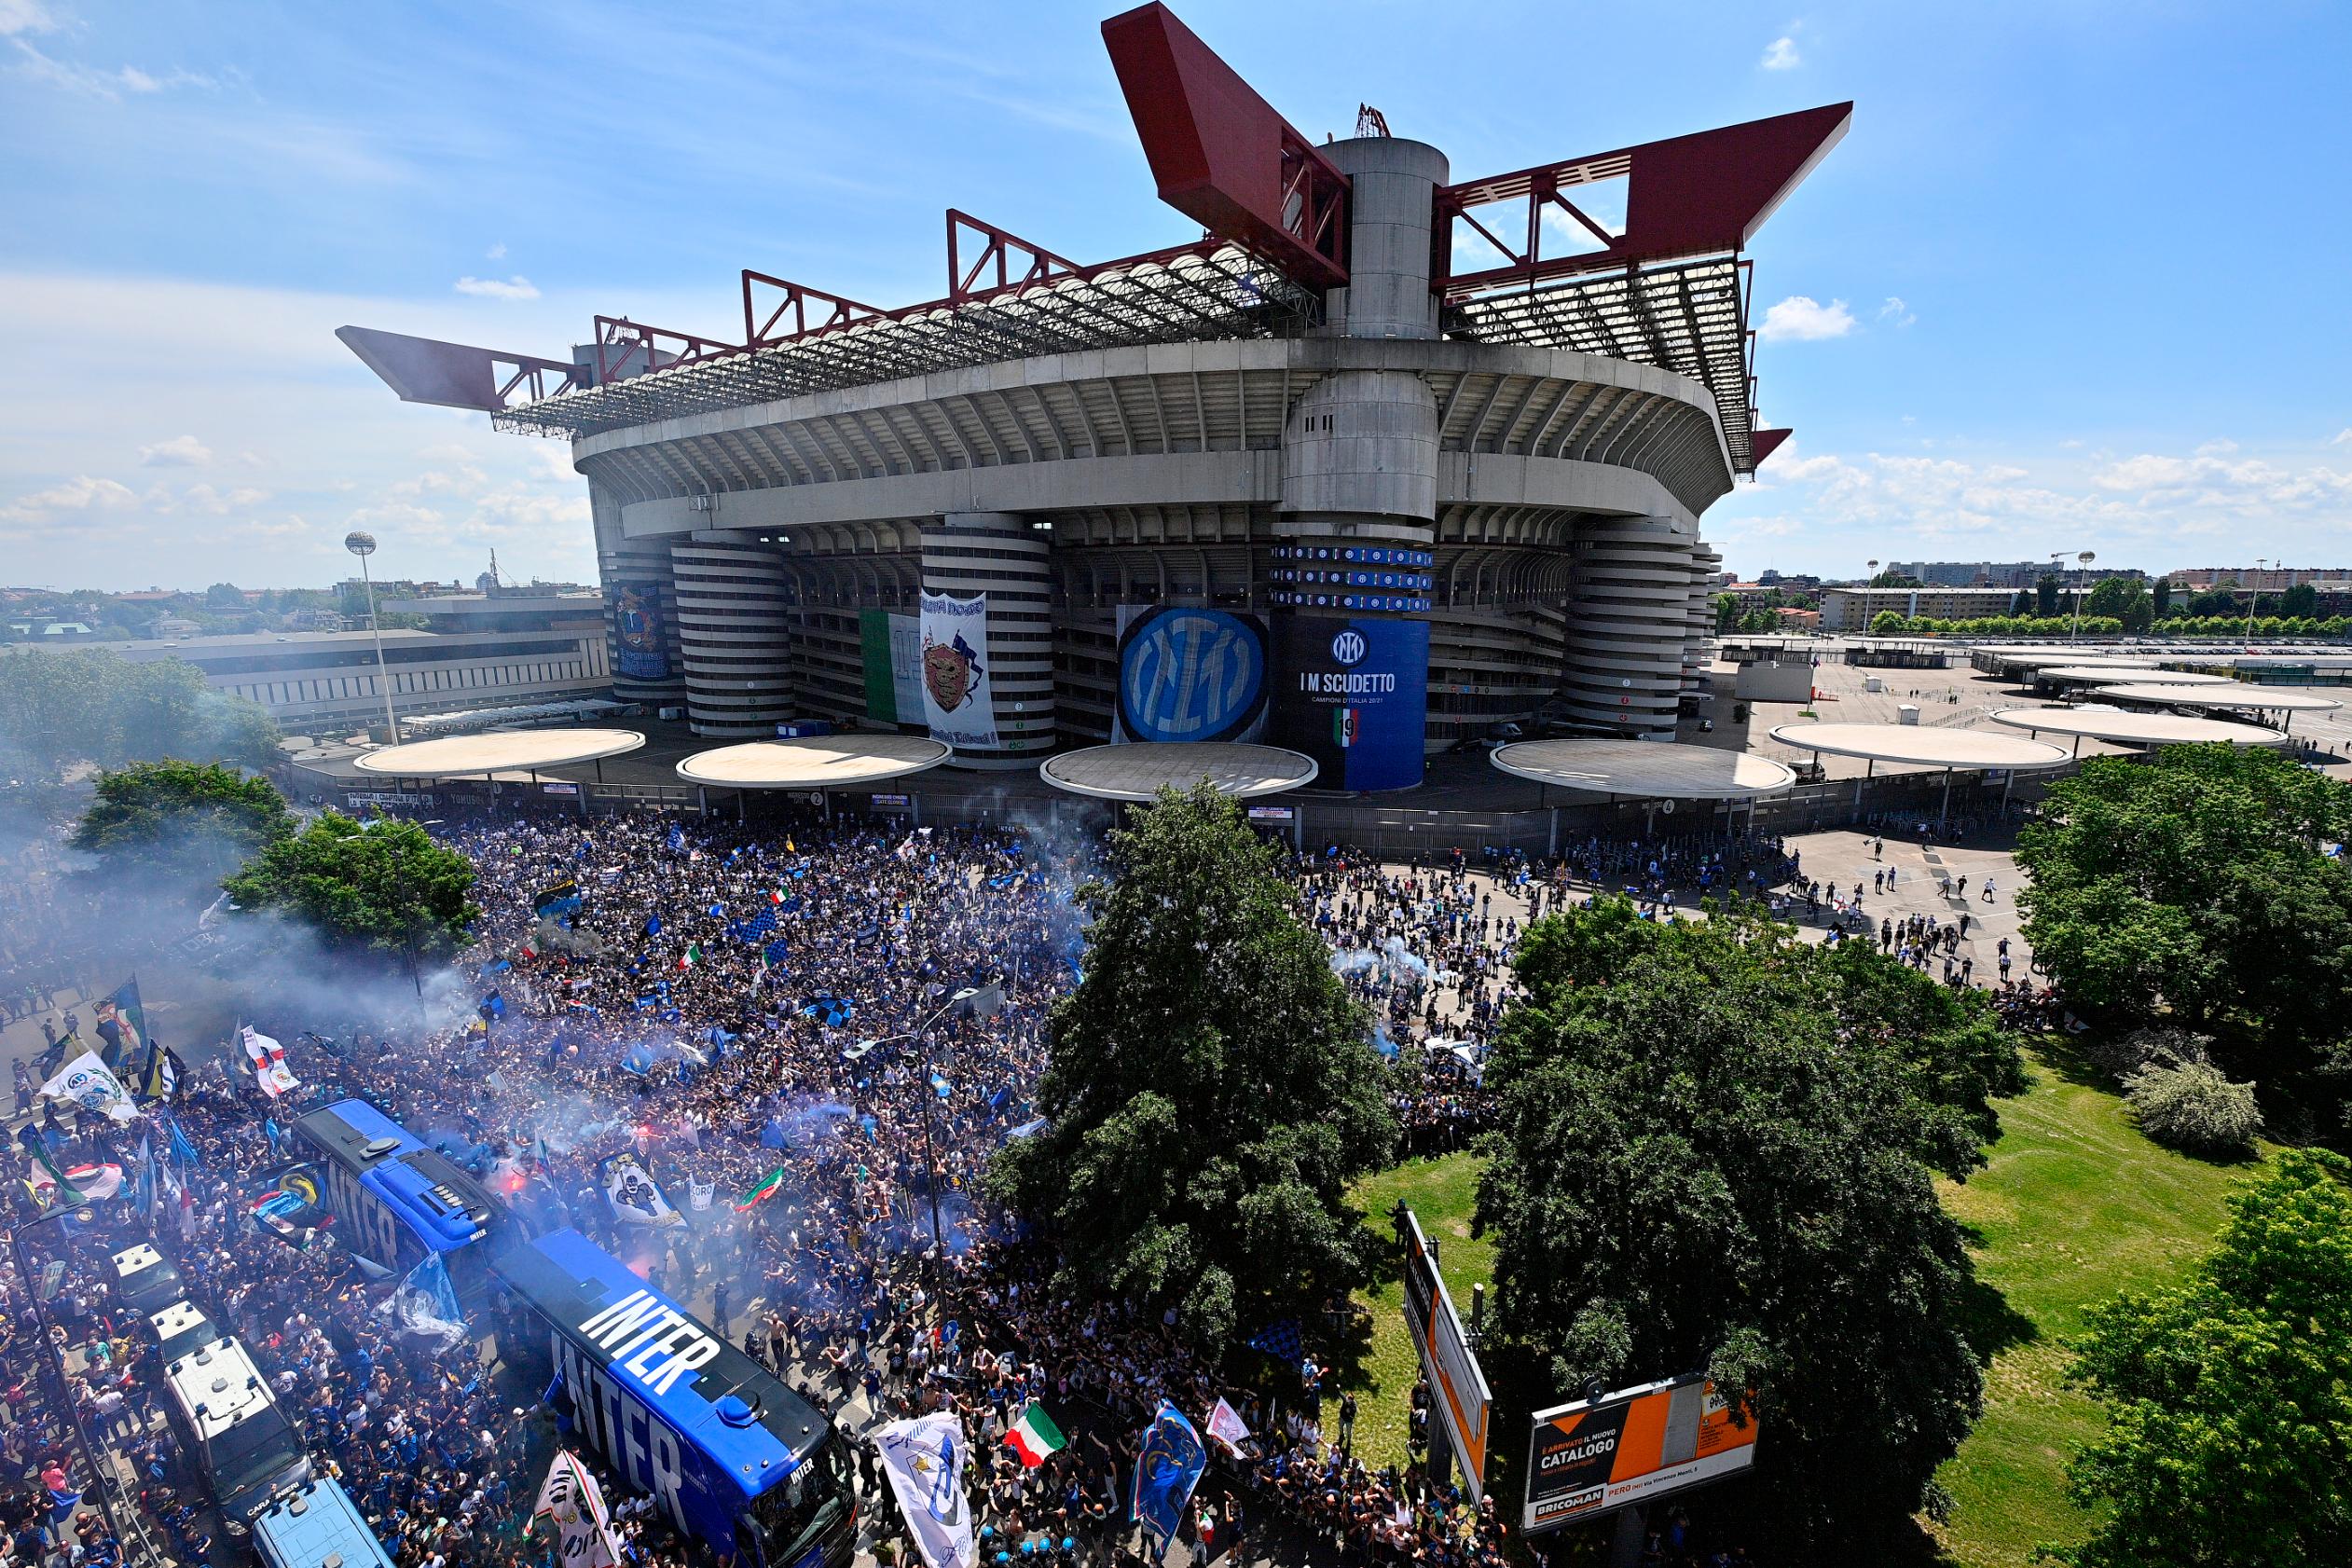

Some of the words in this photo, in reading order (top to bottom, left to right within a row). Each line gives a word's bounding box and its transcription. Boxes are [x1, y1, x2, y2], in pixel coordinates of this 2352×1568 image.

[1300, 672, 1304, 691] I
[1308, 673, 1319, 692] M
[1323, 673, 1396, 693] SCUDETTO
[1338, 718, 1355, 737] 19
[469, 1229, 487, 1242] INTER
[578, 1288, 721, 1396] INTER
[1541, 1437, 1615, 1469] CATALOGO
[1547, 1437, 1583, 1453] ARRIVATO
[1591, 1428, 1616, 1441] NUOVO
[791, 1457, 815, 1485] INTER
[246, 1481, 300, 1517] CARAINIERI
[1536, 1491, 1602, 1516] BRICOMAN
[1608, 1484, 1631, 1498] PERO
